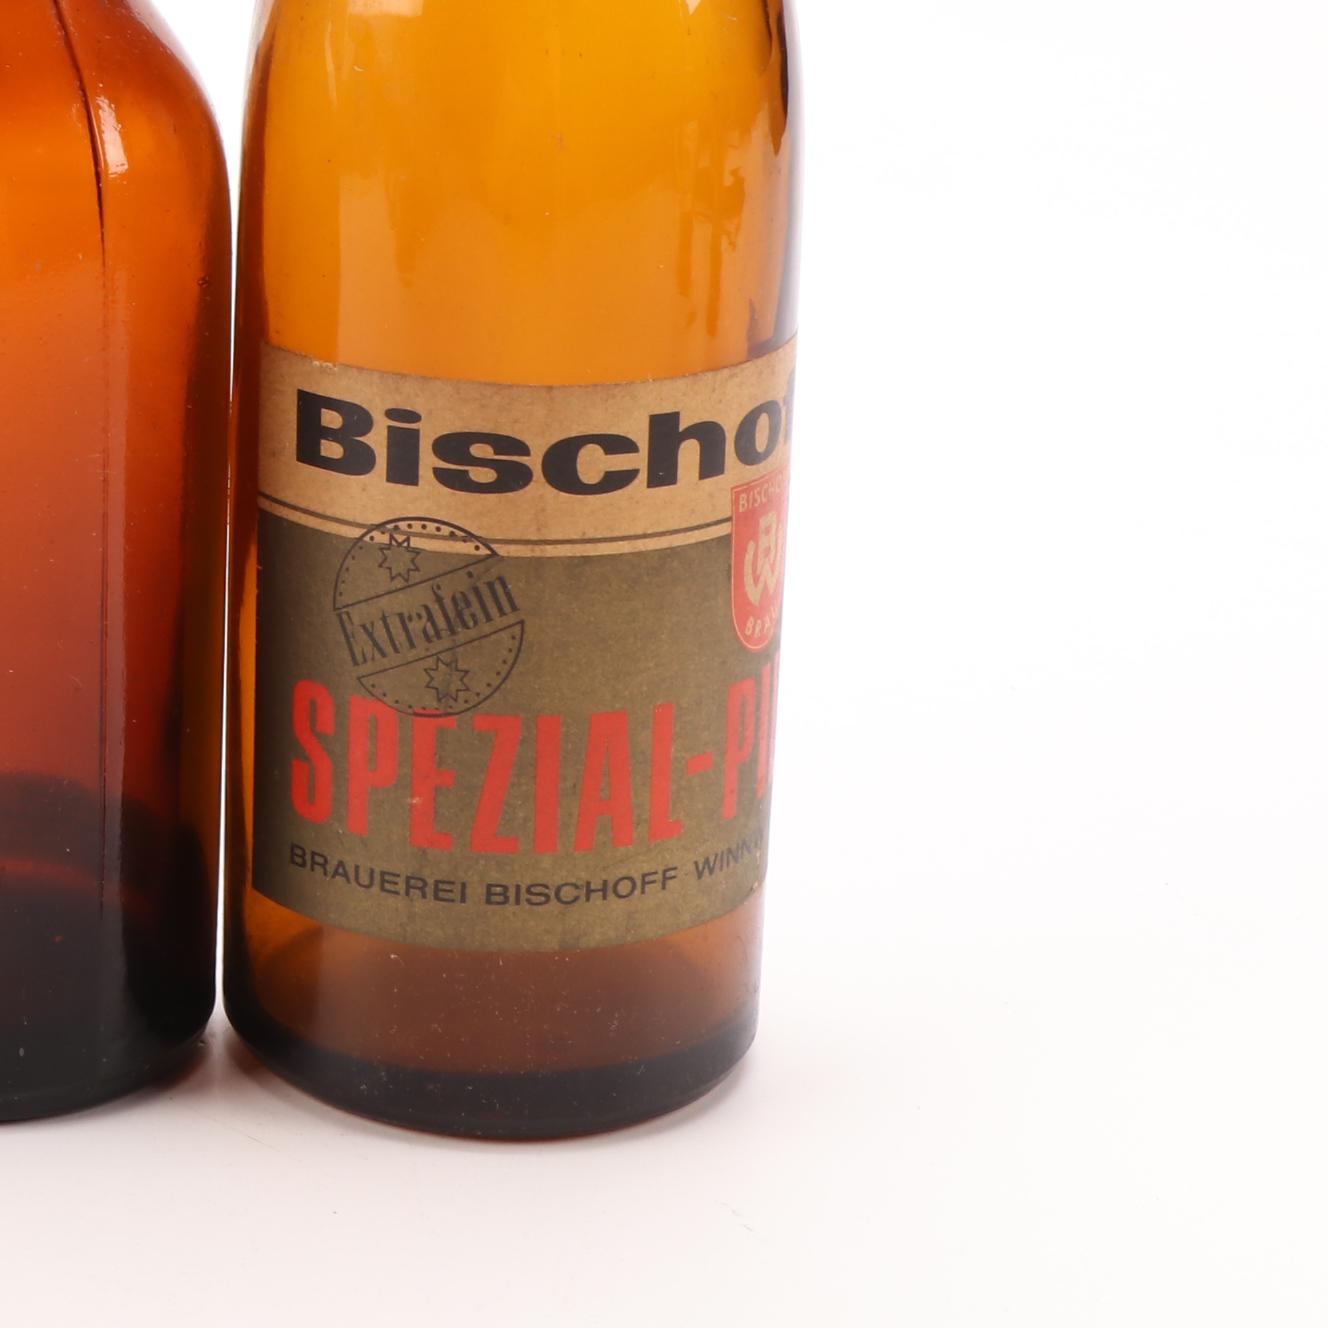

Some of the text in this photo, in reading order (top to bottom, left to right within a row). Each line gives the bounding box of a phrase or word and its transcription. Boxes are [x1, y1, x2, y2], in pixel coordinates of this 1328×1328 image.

[336, 571, 520, 667] Extrafein
[289, 842, 468, 905] BRAUEREI
[483, 866, 679, 907] BISCHOFF
